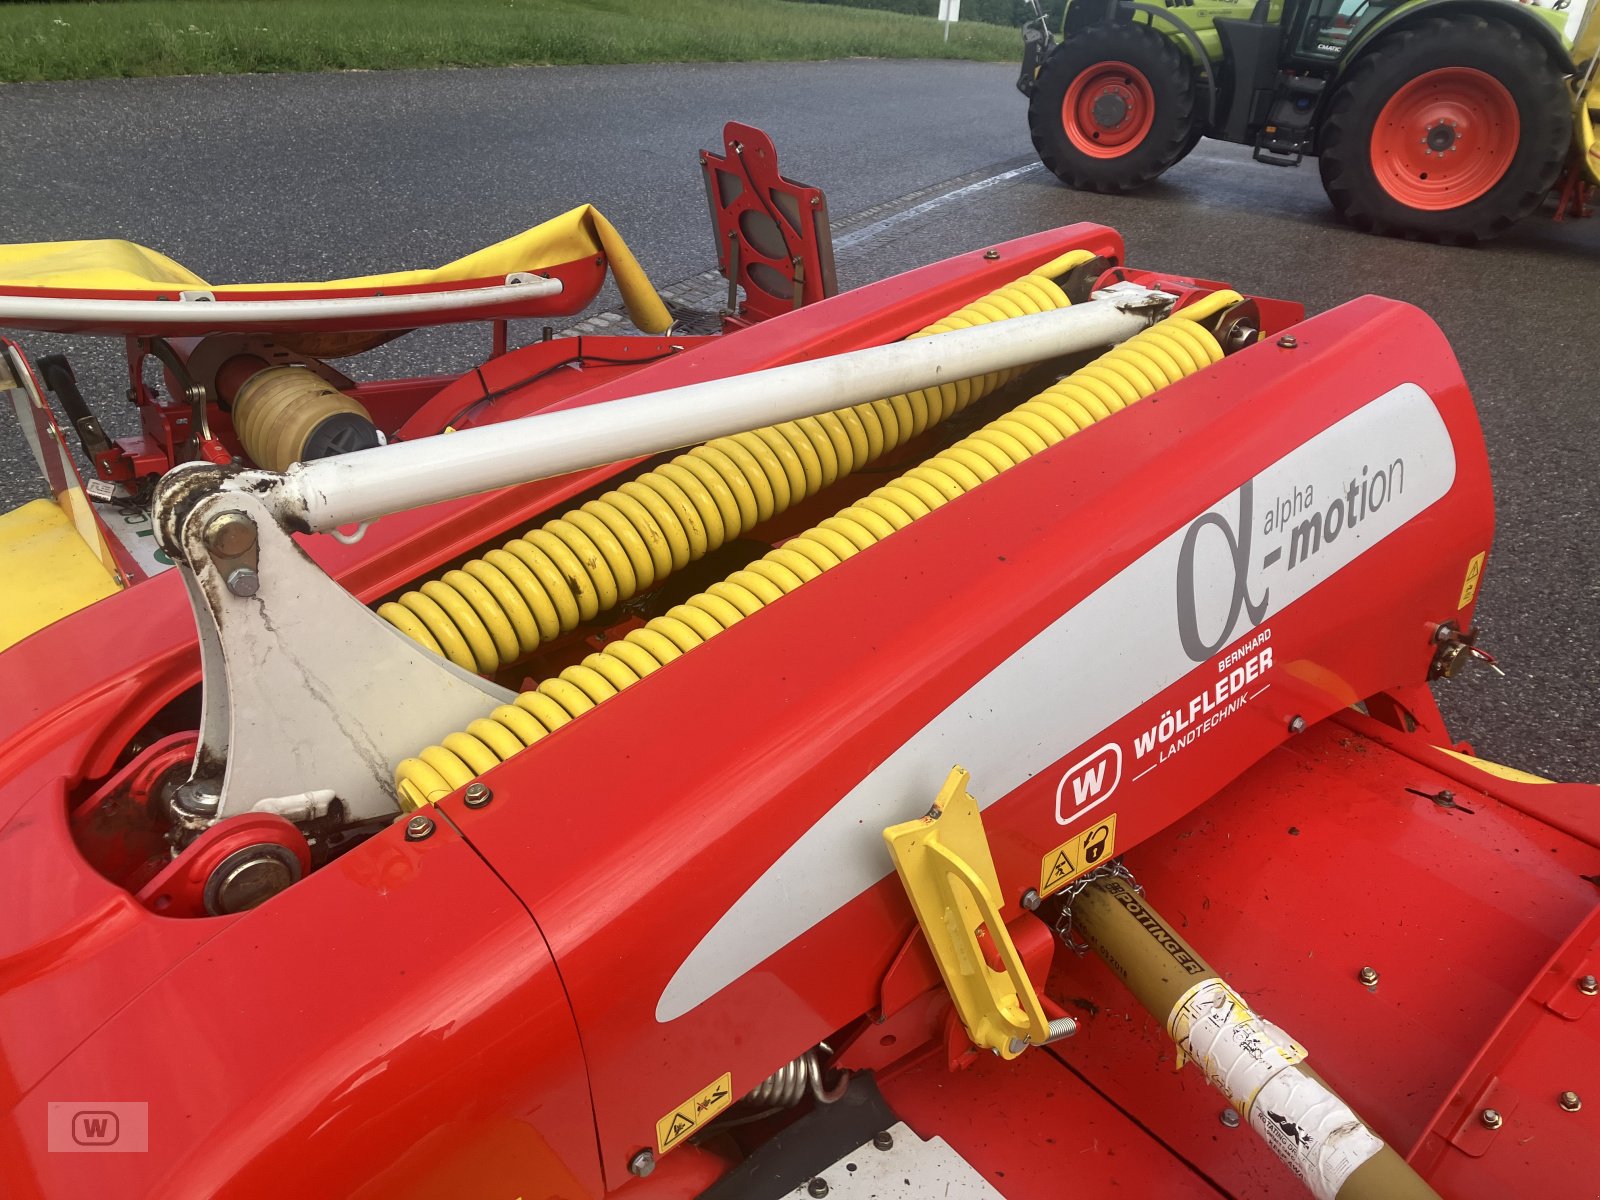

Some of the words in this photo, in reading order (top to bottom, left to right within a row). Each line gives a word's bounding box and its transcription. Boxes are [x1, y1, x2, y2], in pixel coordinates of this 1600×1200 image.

[1317, 43, 1342, 53] CMATIC
[1263, 484, 1314, 535] alpha
[1218, 628, 1272, 673] BERNHARD
[1133, 646, 1274, 760] WÖLFLEDER
[1159, 691, 1249, 764] LANDTECHNIK
[1072, 759, 1107, 806] W
